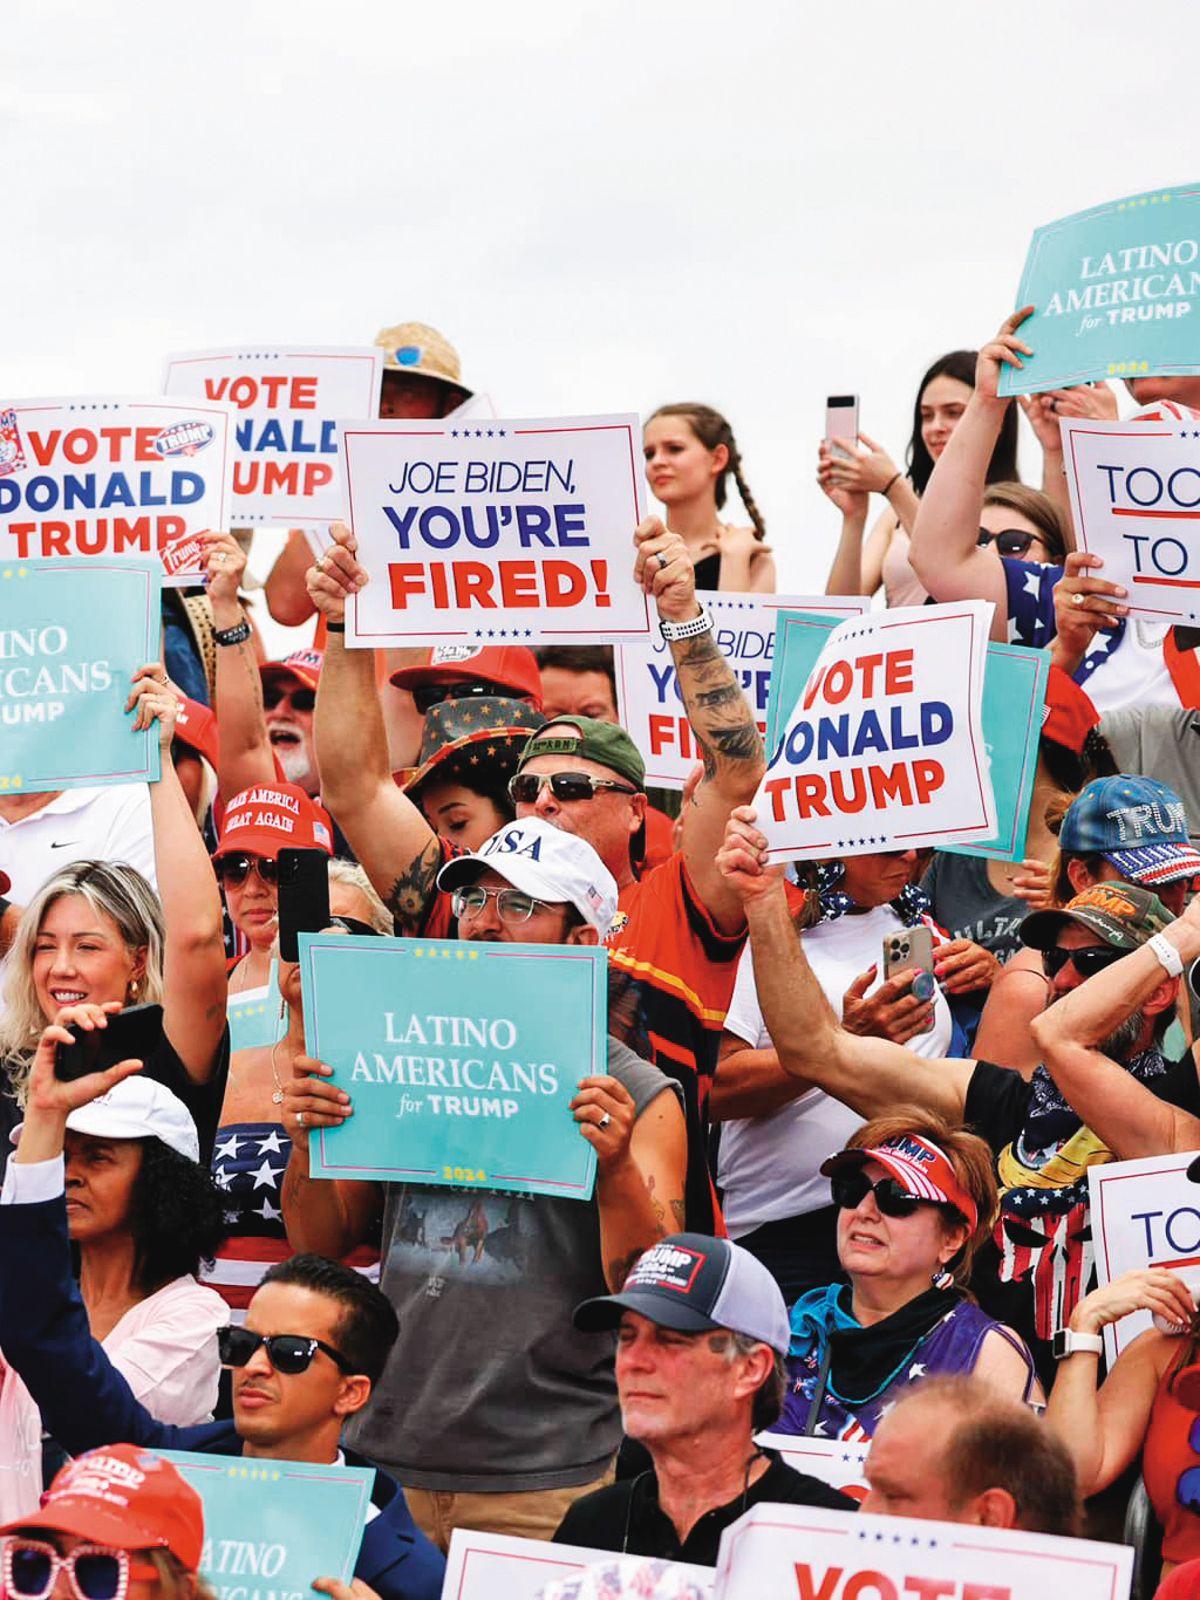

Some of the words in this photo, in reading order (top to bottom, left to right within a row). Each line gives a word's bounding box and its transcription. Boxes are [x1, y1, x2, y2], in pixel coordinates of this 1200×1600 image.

[1079, 239, 1198, 279] LATINO
[1074, 314, 1103, 337] for
[1107, 302, 1191, 325] TRUMP
[204, 375, 319, 410] VOTE
[27, 426, 165, 467] VOTE
[158, 424, 210, 451] TRUMP
[232, 461, 334, 497] UMP
[388, 461, 459, 494] JOE
[464, 459, 576, 495] BIDEN,
[8, 515, 188, 559] TRUMP
[382, 504, 590, 550] YOU'RE
[1122, 533, 1189, 576] TO
[387, 559, 611, 610] FIRED!
[248, 788, 300, 816] AMERICA
[763, 758, 946, 822] TRUMP
[254, 811, 294, 833] AGAIN
[484, 829, 542, 862] USA
[383, 1012, 517, 1050] LATINO
[350, 1051, 559, 1095] AMERICANS
[396, 1093, 423, 1119] for
[427, 1094, 519, 1119] TRUMP
[443, 1166, 487, 1182] 2024
[1131, 1207, 1200, 1257] TO
[200, 1536, 288, 1578] ATINO
